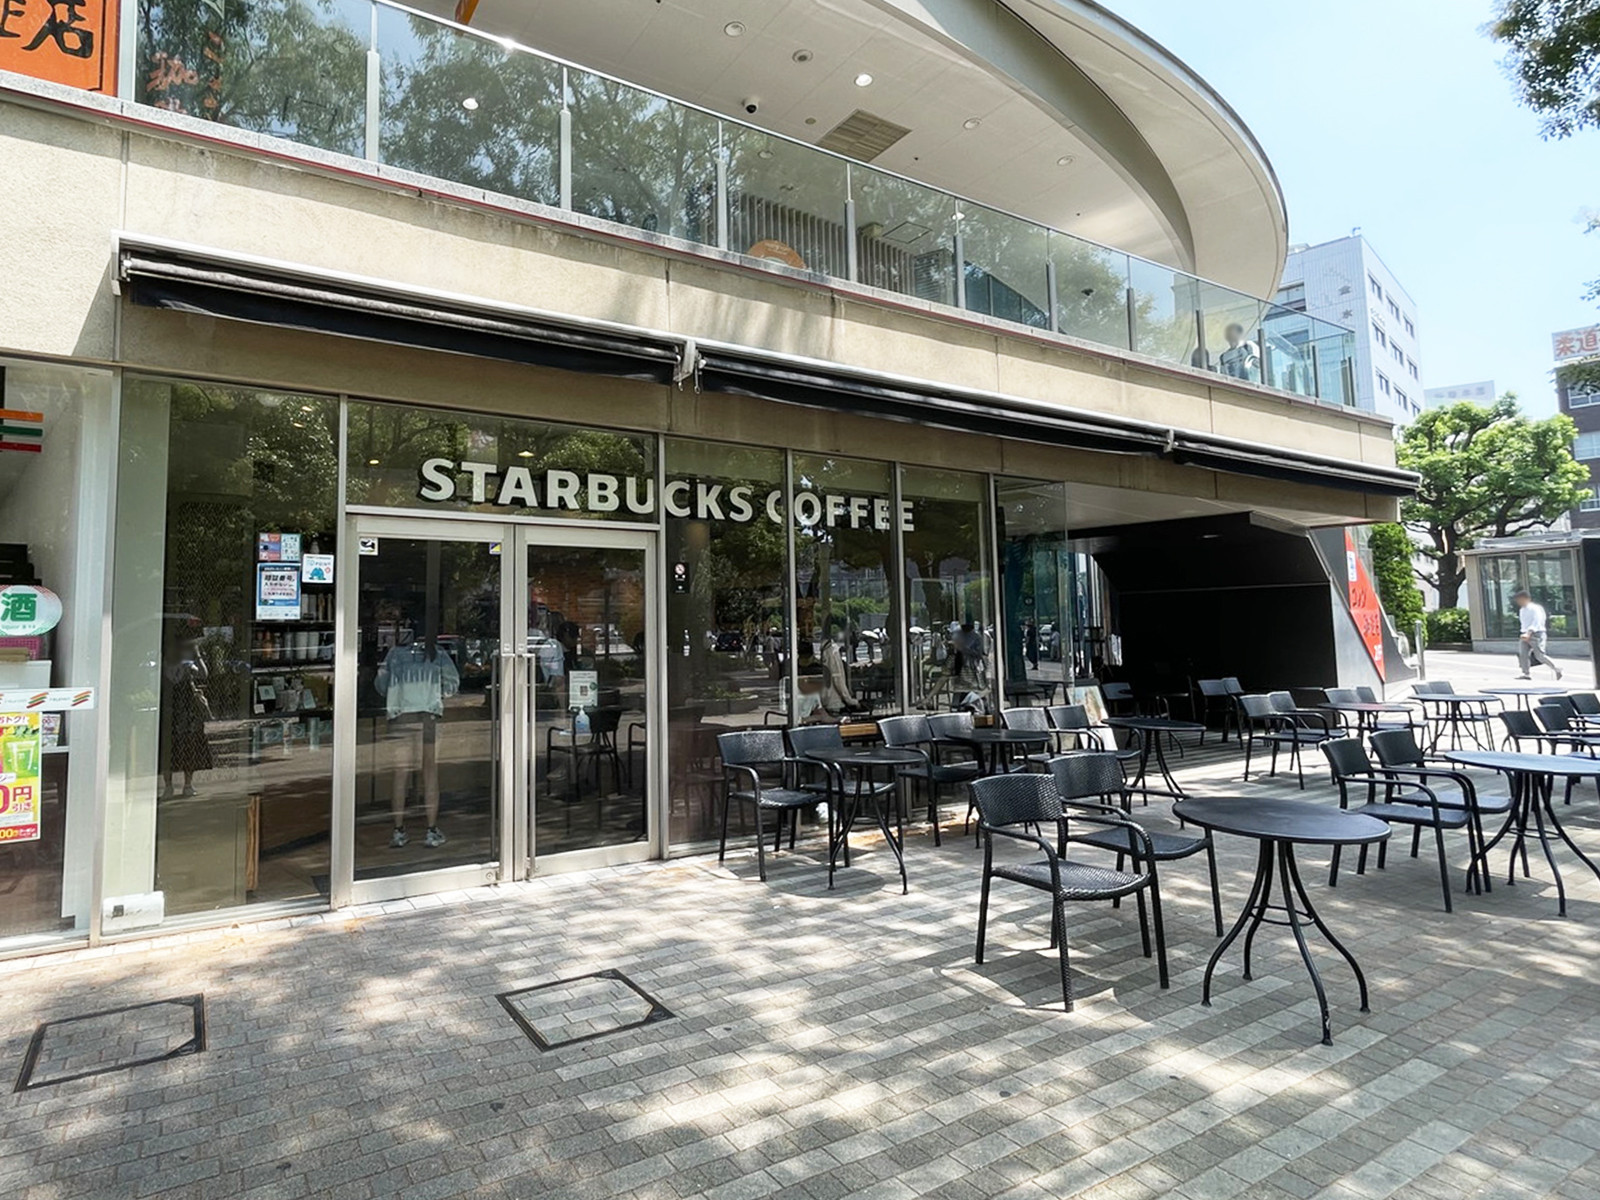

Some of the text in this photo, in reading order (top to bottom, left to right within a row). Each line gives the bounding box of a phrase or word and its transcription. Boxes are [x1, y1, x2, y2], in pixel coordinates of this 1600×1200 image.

[420, 457, 915, 532] STARBUCKS COFFEE
[1, 592, 38, 621] 酒
